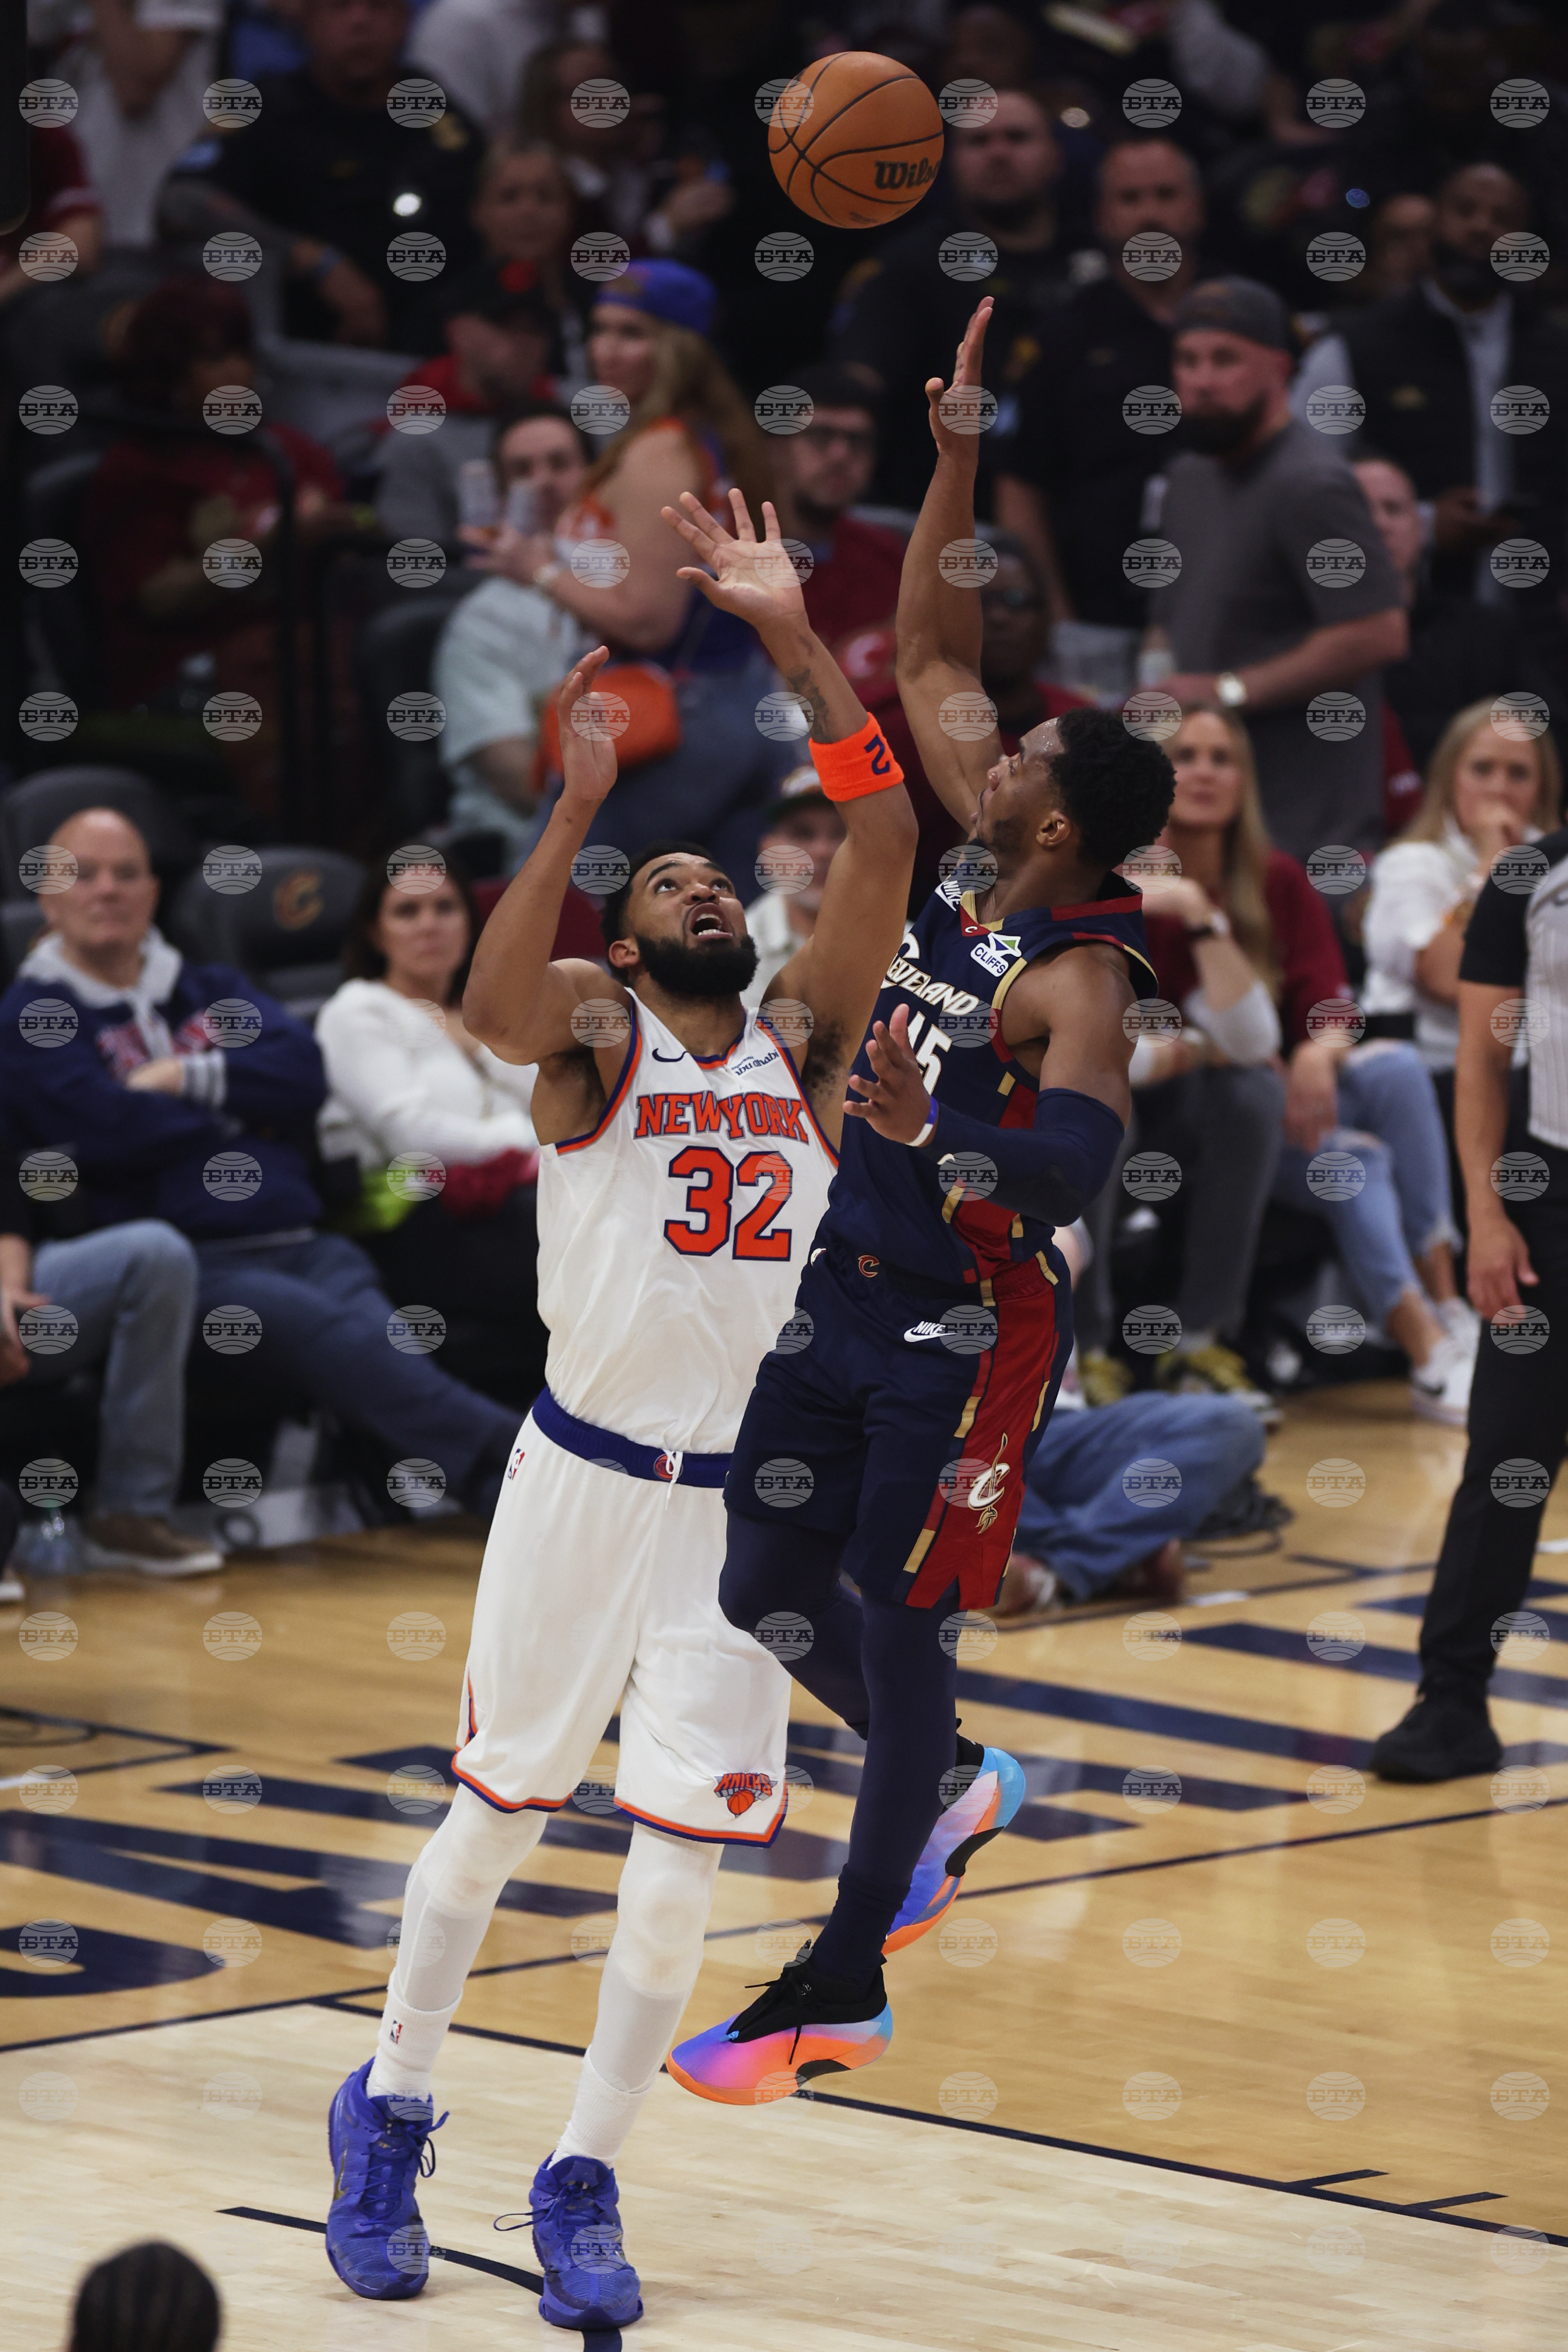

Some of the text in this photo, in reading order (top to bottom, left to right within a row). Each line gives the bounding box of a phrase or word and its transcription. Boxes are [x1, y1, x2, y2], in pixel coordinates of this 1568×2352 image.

[943, 880, 963, 907] NIKE
[974, 947, 1006, 974] CLIFFS
[880, 933, 979, 1016] EVELAND
[664, 1146, 793, 1262] 32
[913, 1321, 946, 1335] NIKE
[714, 1773, 773, 1797] KNICKS
